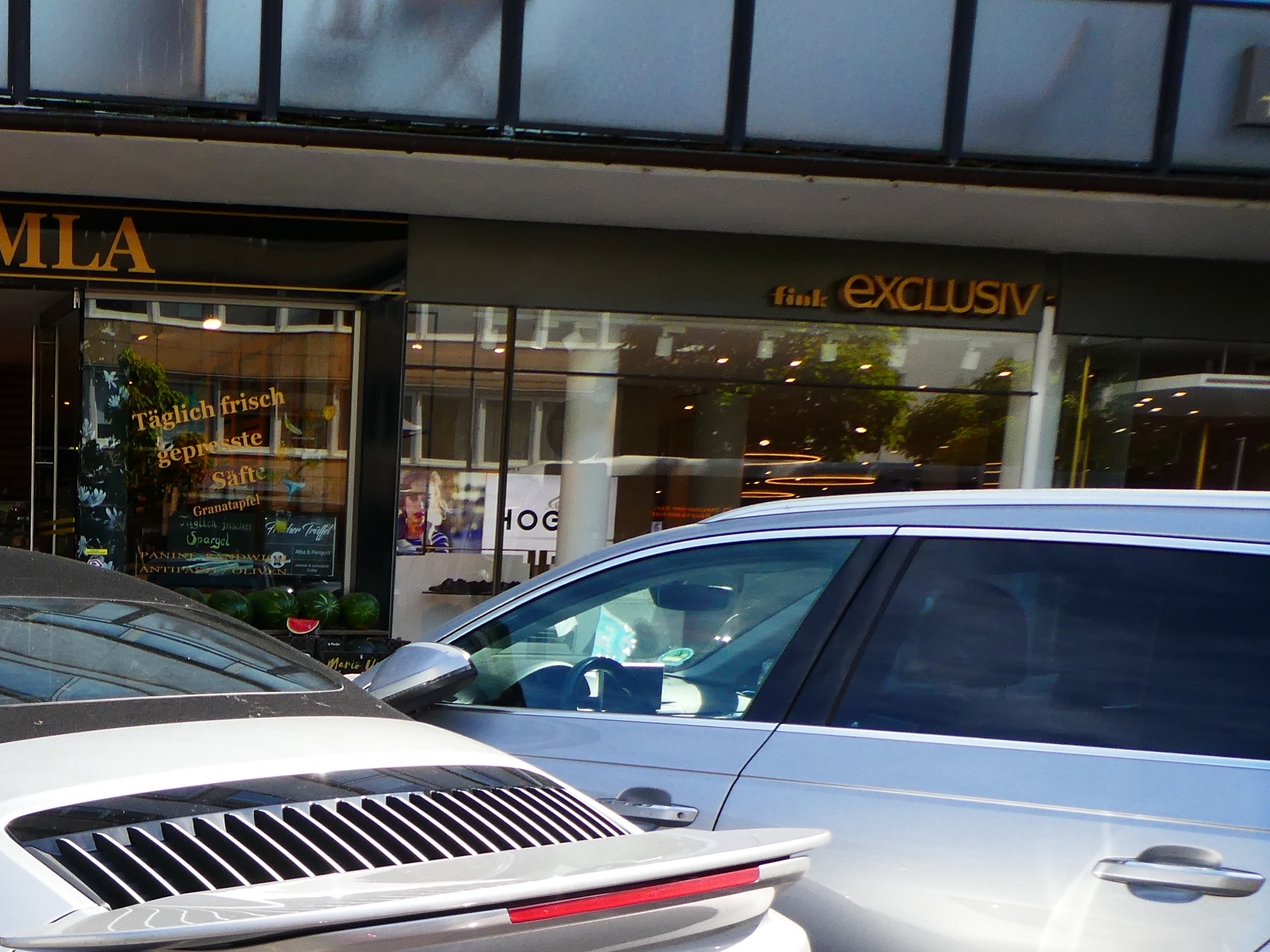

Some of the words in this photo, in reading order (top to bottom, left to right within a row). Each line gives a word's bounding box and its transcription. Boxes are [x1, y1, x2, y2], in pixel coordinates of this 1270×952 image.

[770, 285, 826, 308] fink
[132, 399, 216, 431] Täglich
[220, 386, 286, 416] frisch
[156, 432, 264, 469] gepresste
[212, 465, 268, 490] Säfte
[192, 493, 261, 517] Granatapfel
[186, 531, 230, 549] Spargel
[232, 567, 287, 576] OLIVEN
